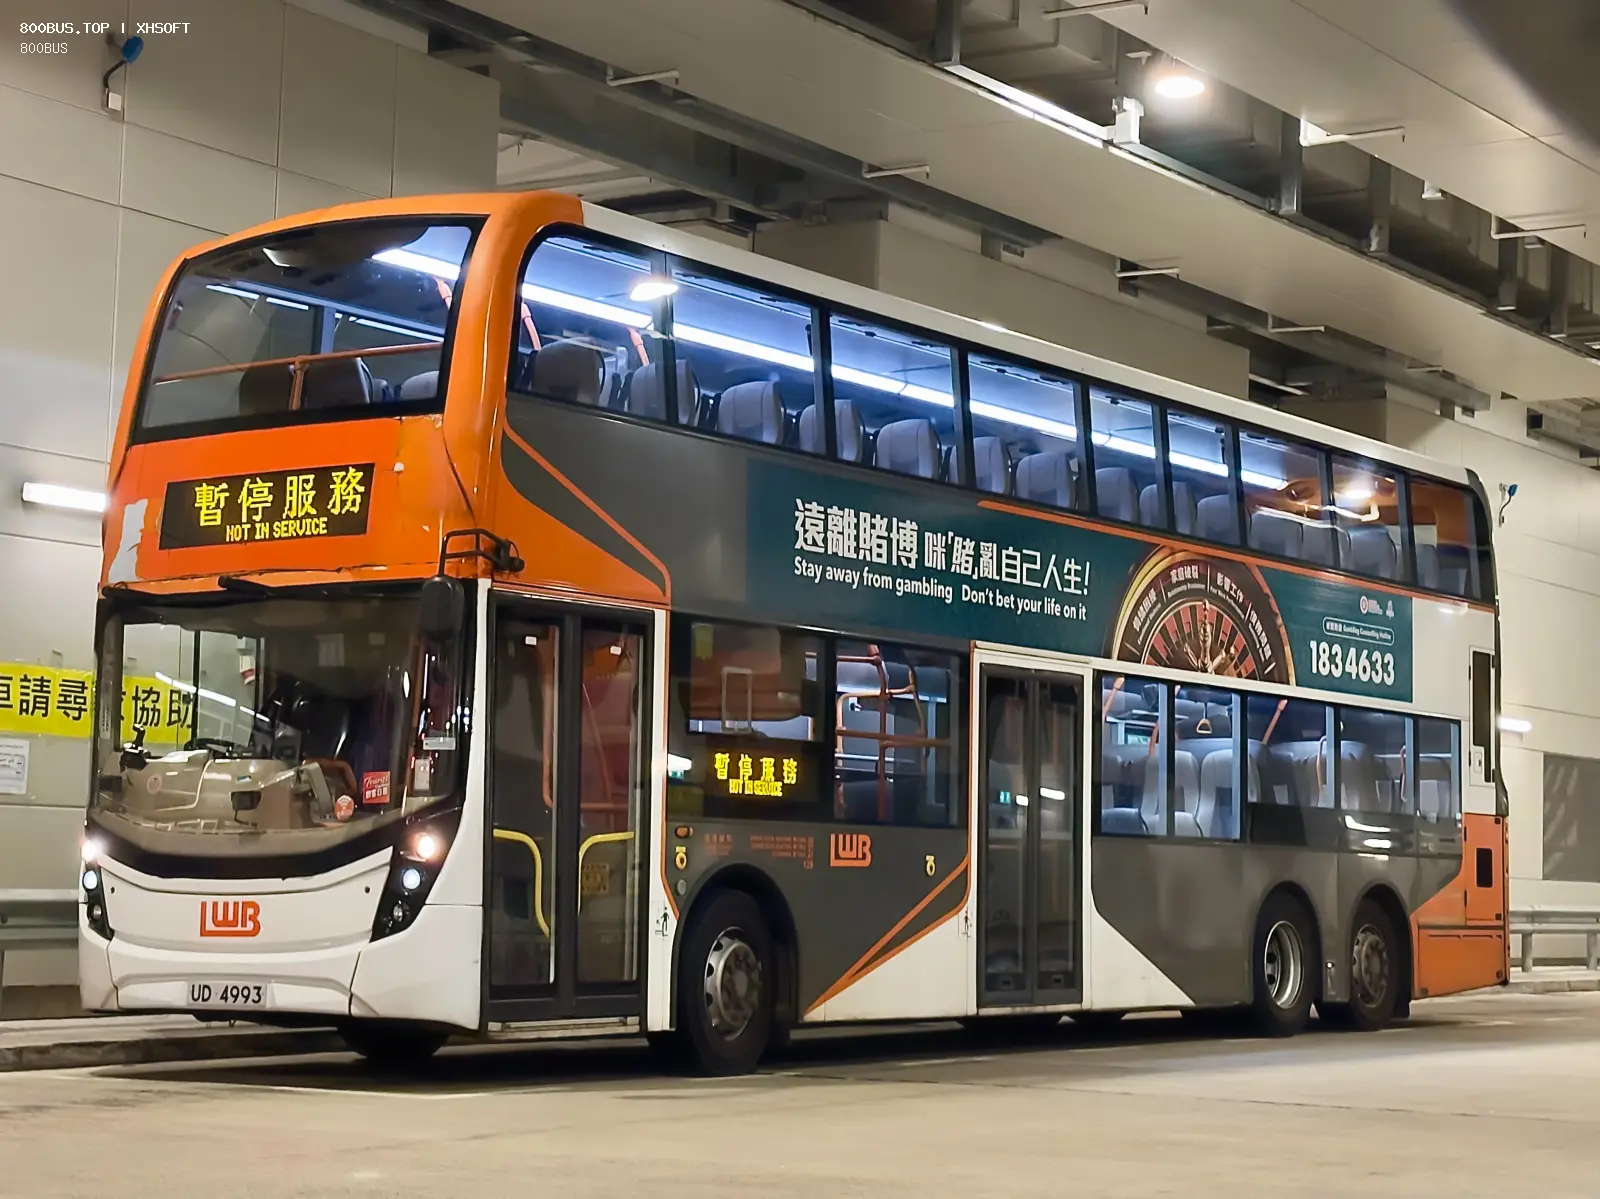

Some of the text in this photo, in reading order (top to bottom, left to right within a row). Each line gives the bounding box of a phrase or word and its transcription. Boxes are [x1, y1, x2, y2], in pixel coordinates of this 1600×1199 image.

[193, 466, 365, 527] 暫停服務
[225, 517, 328, 542] NOT IN SERVICE
[794, 498, 918, 570] 遠離賭博
[794, 556, 1087, 621] Stay away from gambling Don't bet your life on it
[830, 833, 872, 868] LWB
[200, 901, 261, 937] LWB
[191, 984, 262, 1004] UD 4993
